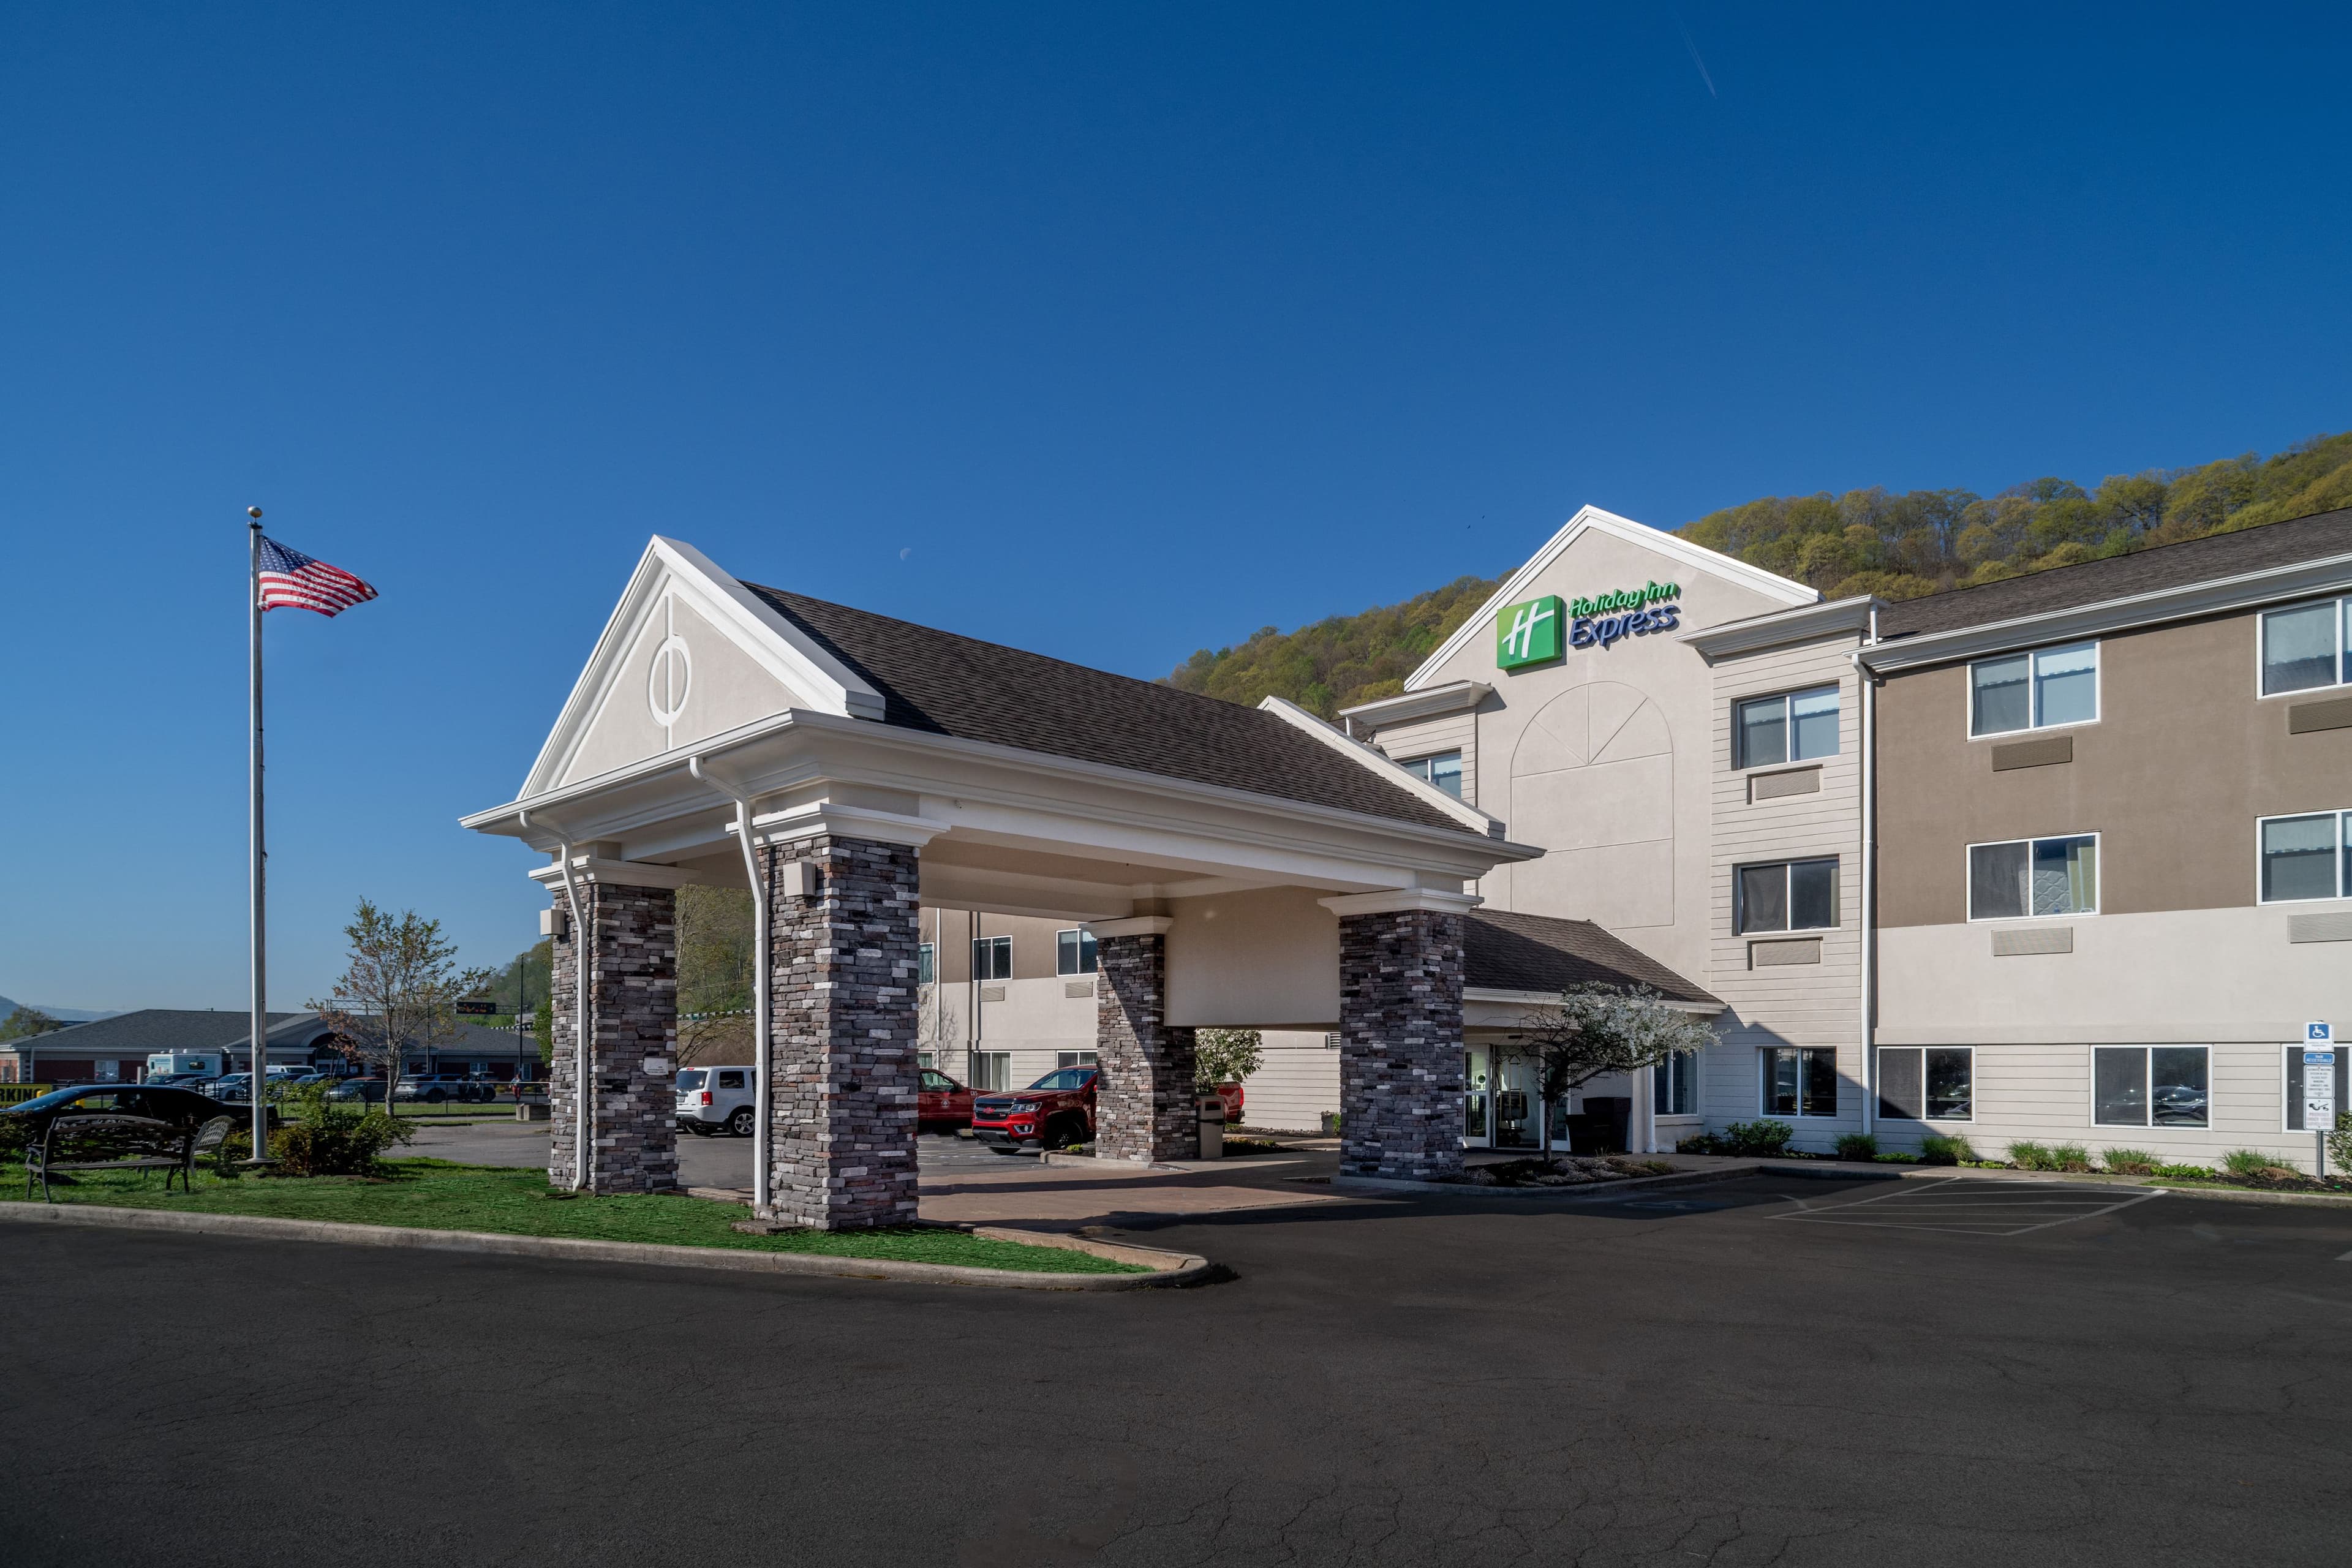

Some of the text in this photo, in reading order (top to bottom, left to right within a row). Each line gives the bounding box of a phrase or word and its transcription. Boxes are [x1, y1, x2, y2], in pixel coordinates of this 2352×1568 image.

[1568, 580, 1678, 618] Holiday Inn
[1569, 605, 1680, 647] Express
